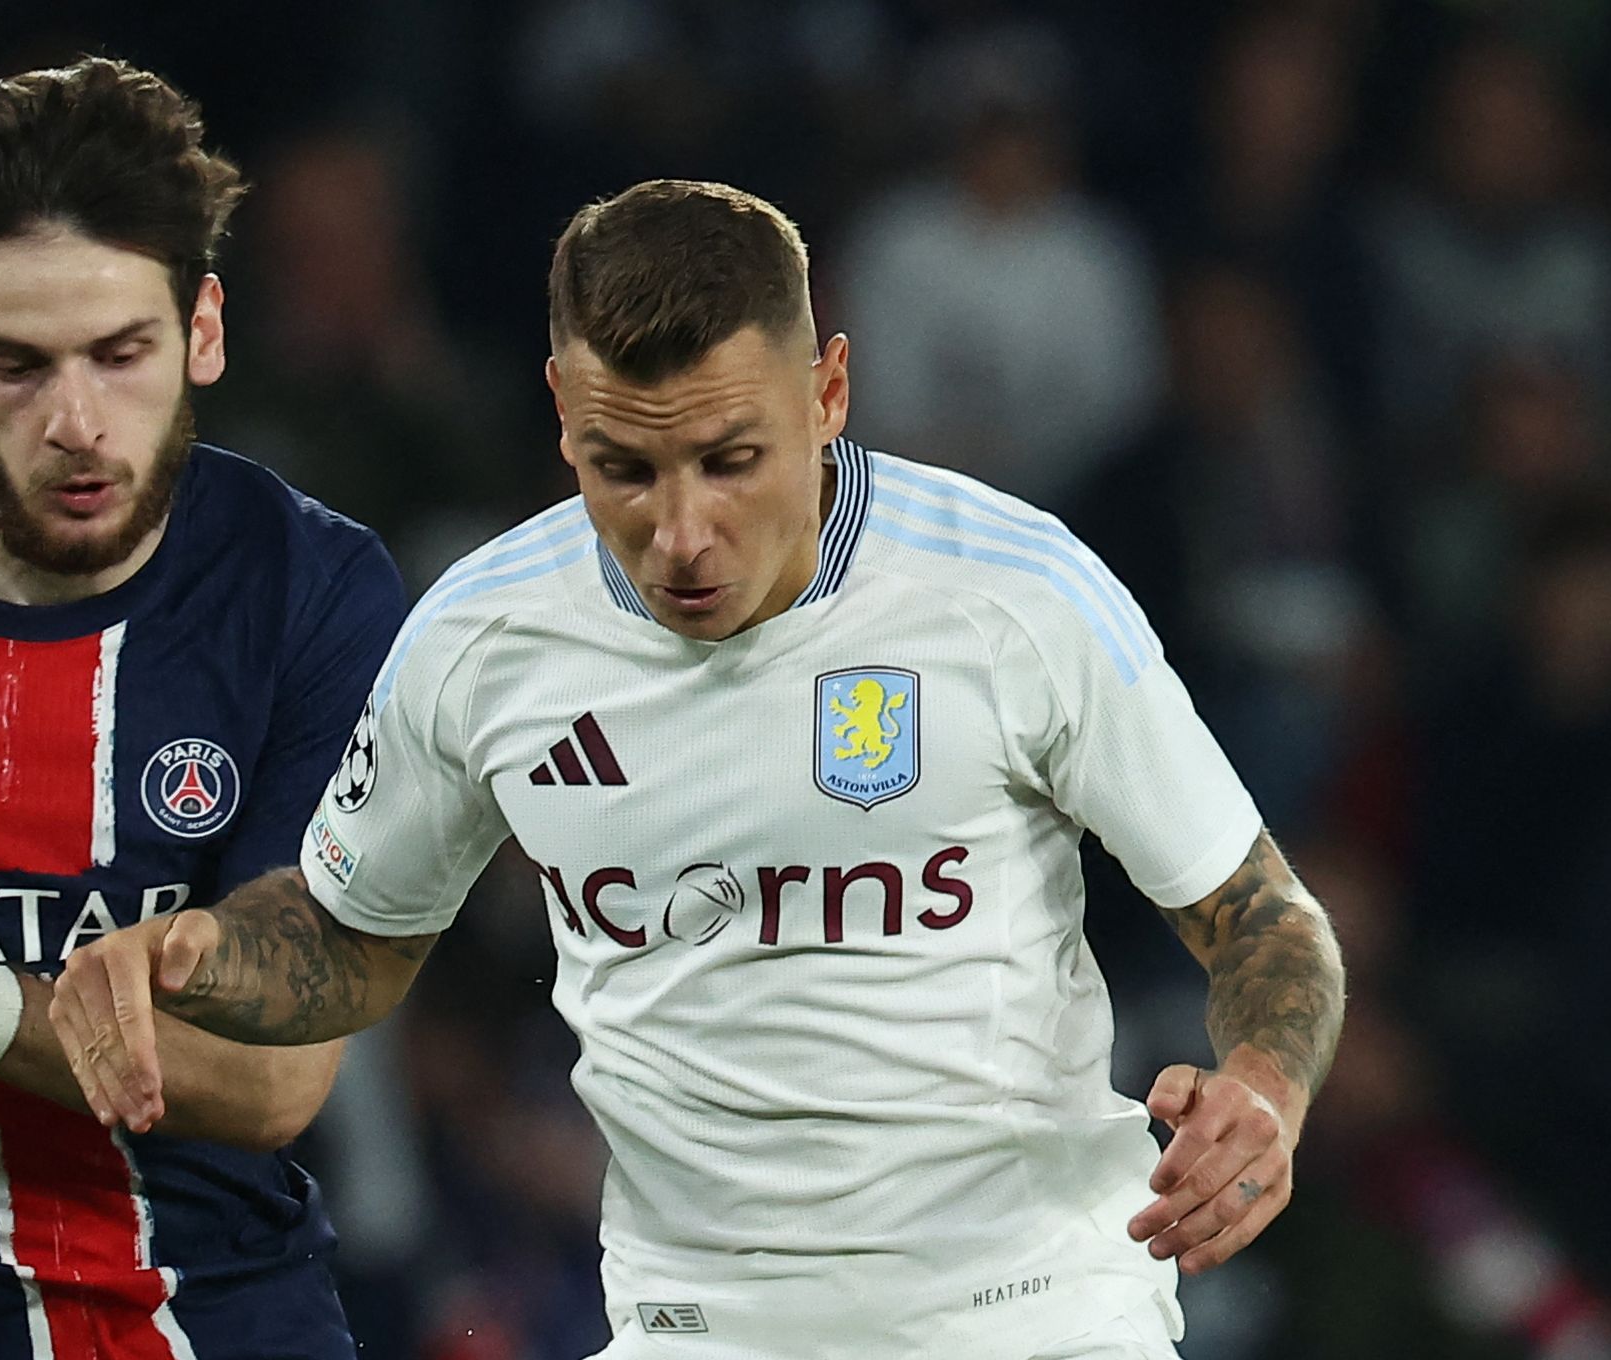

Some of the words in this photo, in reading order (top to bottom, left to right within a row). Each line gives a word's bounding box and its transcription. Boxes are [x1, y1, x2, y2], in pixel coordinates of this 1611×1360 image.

[158, 743, 225, 768] PARIS
[826, 774, 869, 793] ASTON
[871, 772, 909, 793] VILLA
